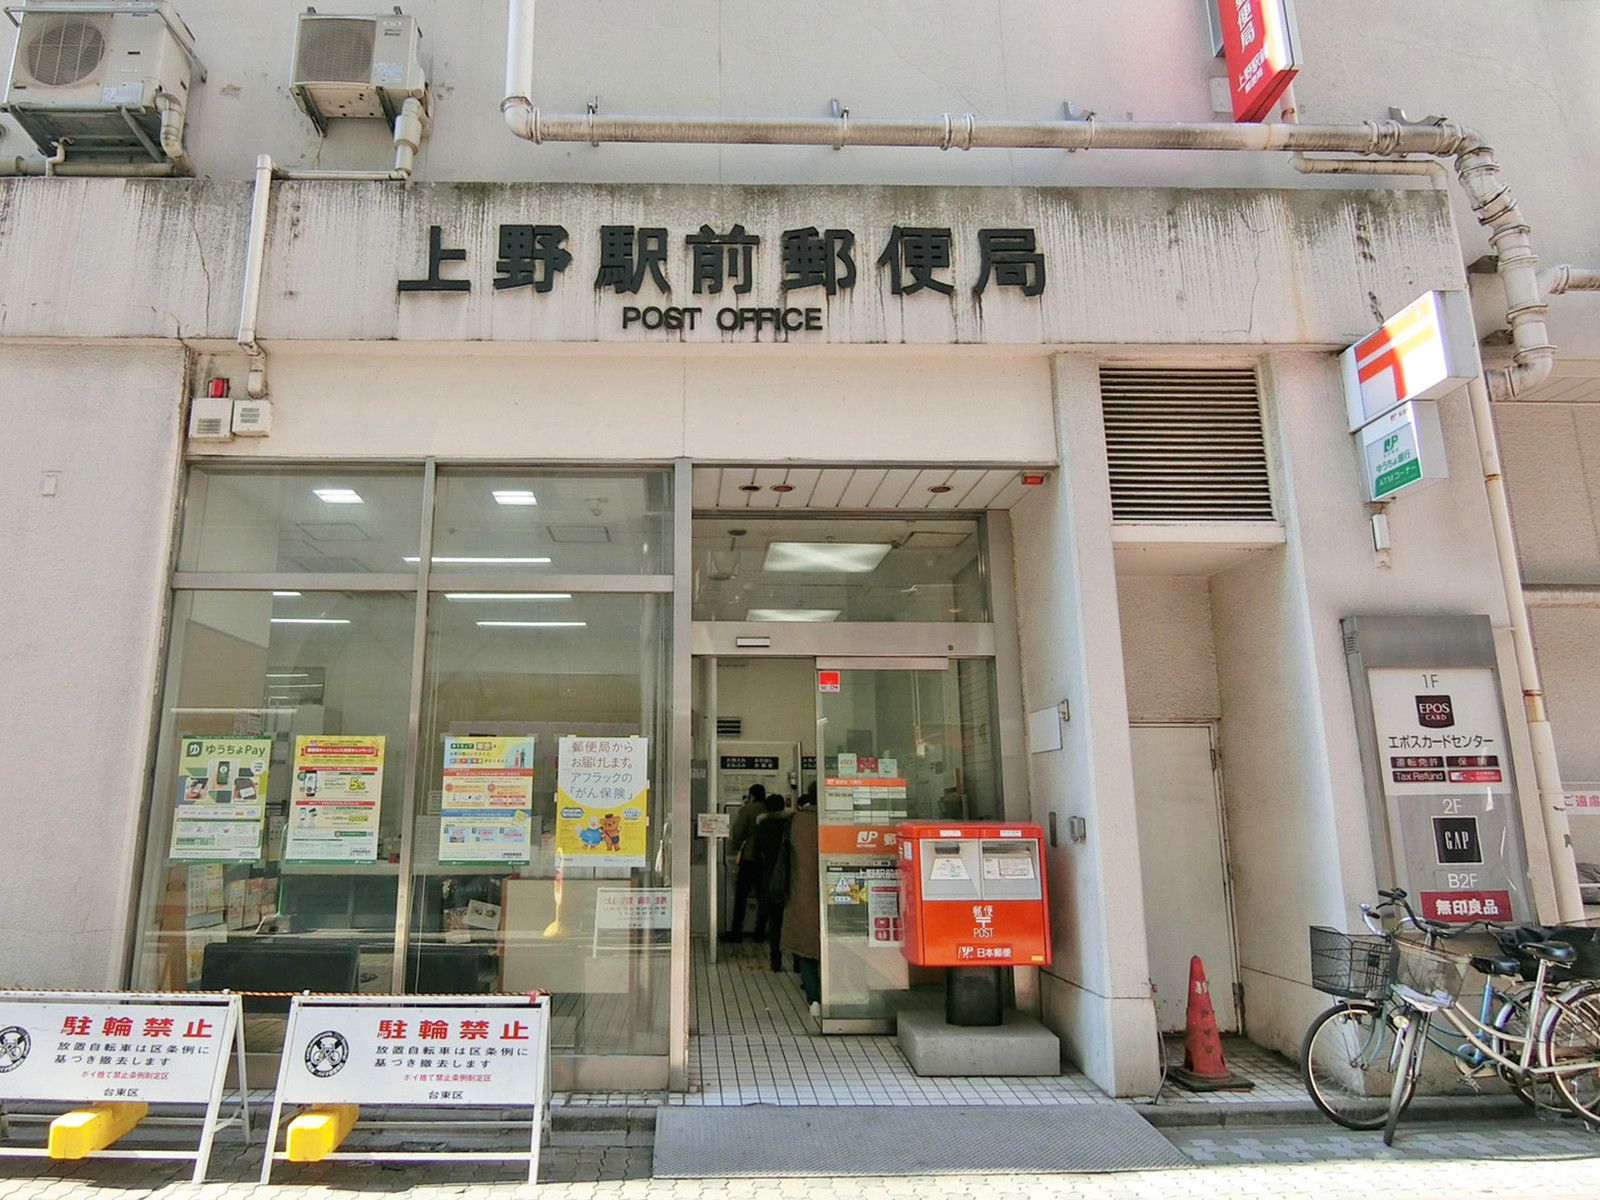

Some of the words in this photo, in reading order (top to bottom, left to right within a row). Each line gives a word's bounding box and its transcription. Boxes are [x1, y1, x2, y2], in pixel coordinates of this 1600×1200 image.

[1234, 0, 1256, 53] 便局
[398, 223, 1046, 297] 上野駅前郵便局
[623, 307, 701, 330] POST
[716, 306, 822, 330] OFFICE
[1376, 449, 1411, 473] ゆうちょ銀行
[1378, 466, 1417, 487] ATMコーナー
[1423, 674, 1439, 688] 1F
[1418, 703, 1450, 714] EPOS
[571, 741, 633, 753] 郵便局から
[1388, 735, 1494, 749] エポスカードセンター
[205, 744, 266, 757] ゆうちょPay
[571, 757, 633, 769] お届けします。
[1396, 758, 1439, 767] 運転免許
[571, 772, 633, 783] アフラックの
[1413, 772, 1443, 781] Refund
[570, 787, 633, 800] 「がん保険」
[1442, 799, 1463, 814] 2F
[1444, 831, 1469, 849] GAP
[1447, 874, 1478, 889] B2F
[973, 905, 993, 917] 郵便
[1435, 899, 1499, 916] 無印良品
[973, 928, 994, 938] POST
[977, 948, 1012, 958] 日本郵便
[60, 1016, 213, 1038] 駐輪禁止
[377, 1019, 530, 1040] 駐輪禁止
[57, 1041, 210, 1055] 放置自転車は区条例に
[375, 1045, 529, 1056] 放置自転車は区条例に
[81, 1070, 170, 1080] ポイ捨て禁止条例制定区
[403, 1073, 492, 1082] ポイ捨て禁止条例制定区
[103, 1087, 140, 1097] 台東区
[428, 1091, 464, 1100] 台東区
